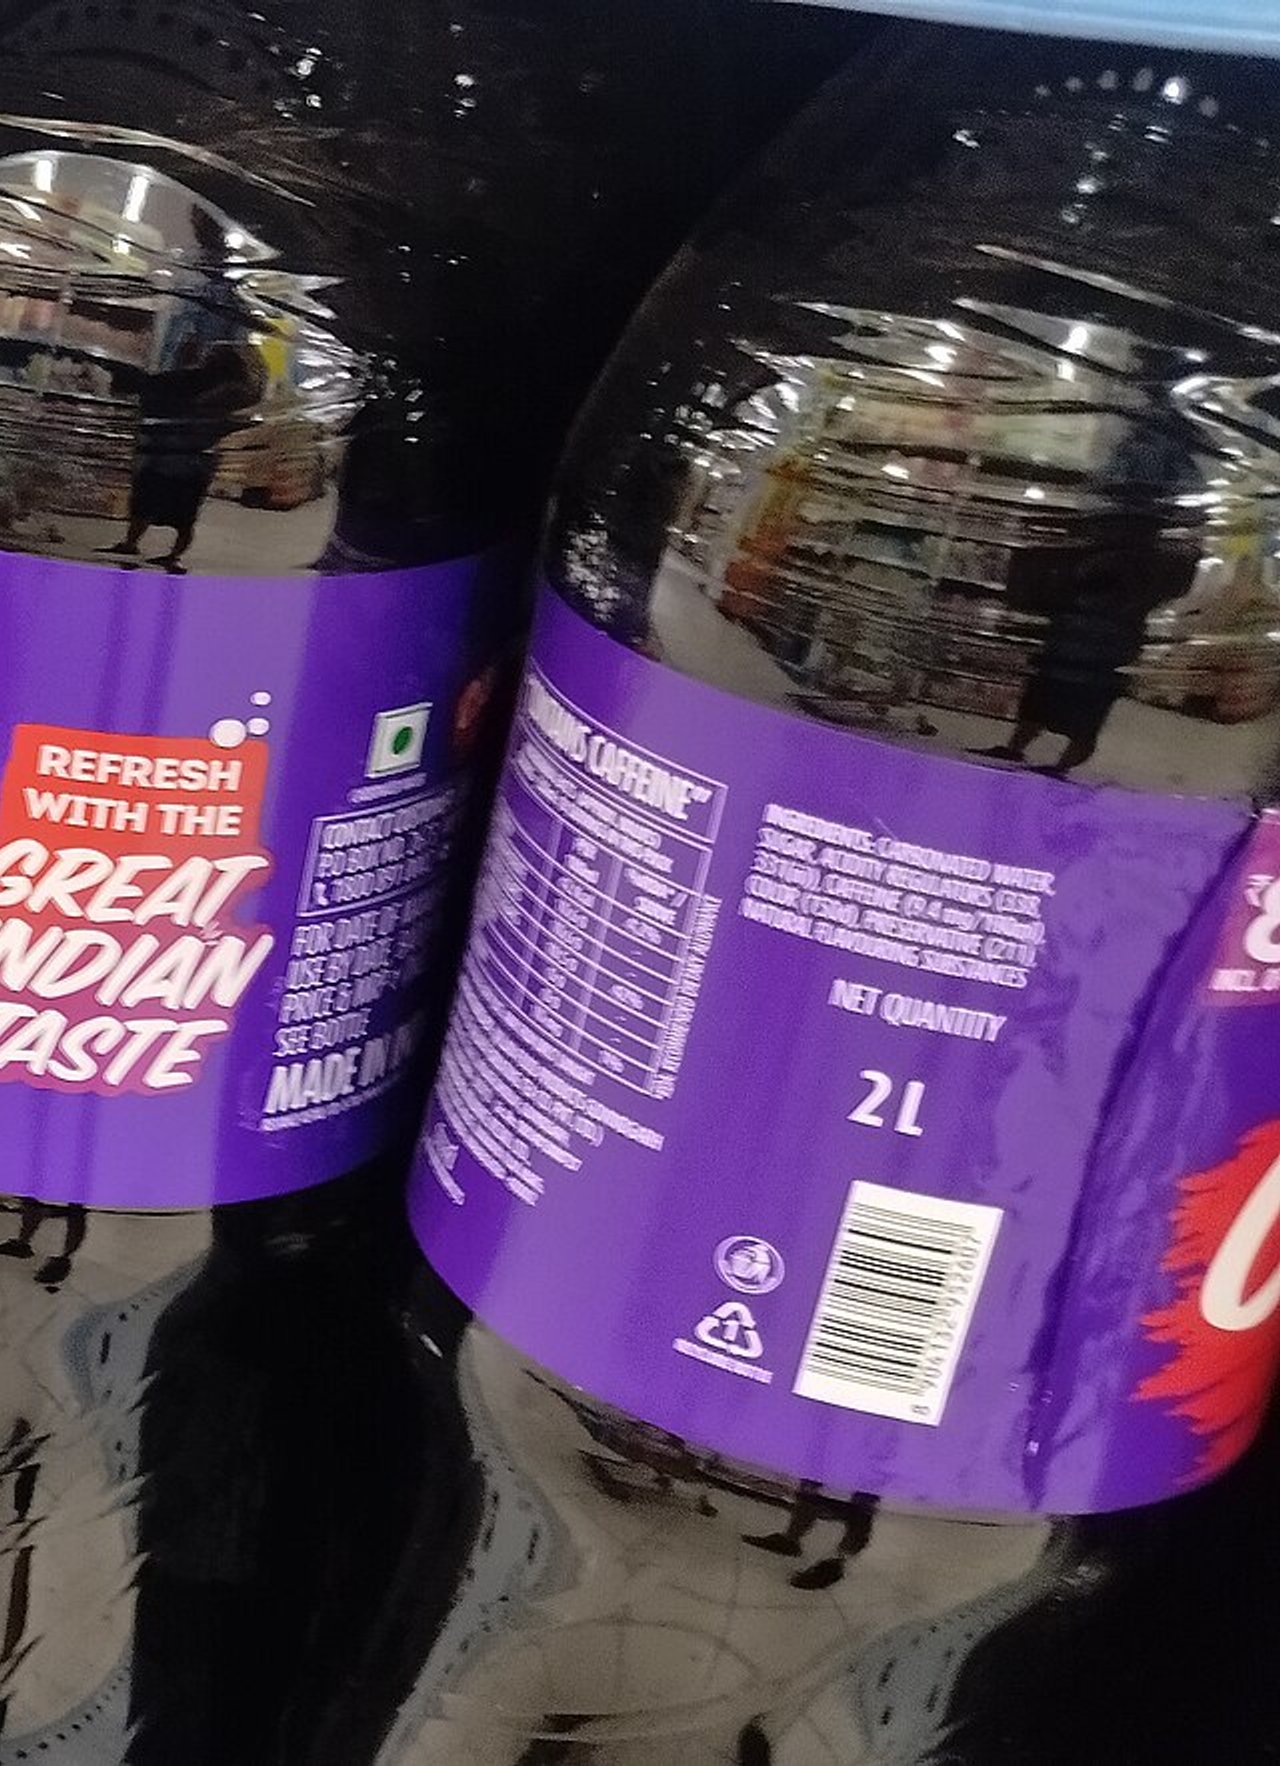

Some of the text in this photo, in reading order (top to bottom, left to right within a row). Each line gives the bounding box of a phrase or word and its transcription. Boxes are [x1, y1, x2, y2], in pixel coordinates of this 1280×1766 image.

[36, 744, 243, 792] REFRESH
[23, 786, 244, 837] WITH THE
[290, 921, 335, 957] FOR
[285, 956, 328, 990] USE
[827, 978, 1008, 1043] NET QUANTITY
[272, 1024, 312, 1058] SEE
[263, 1045, 362, 1115] MADE
